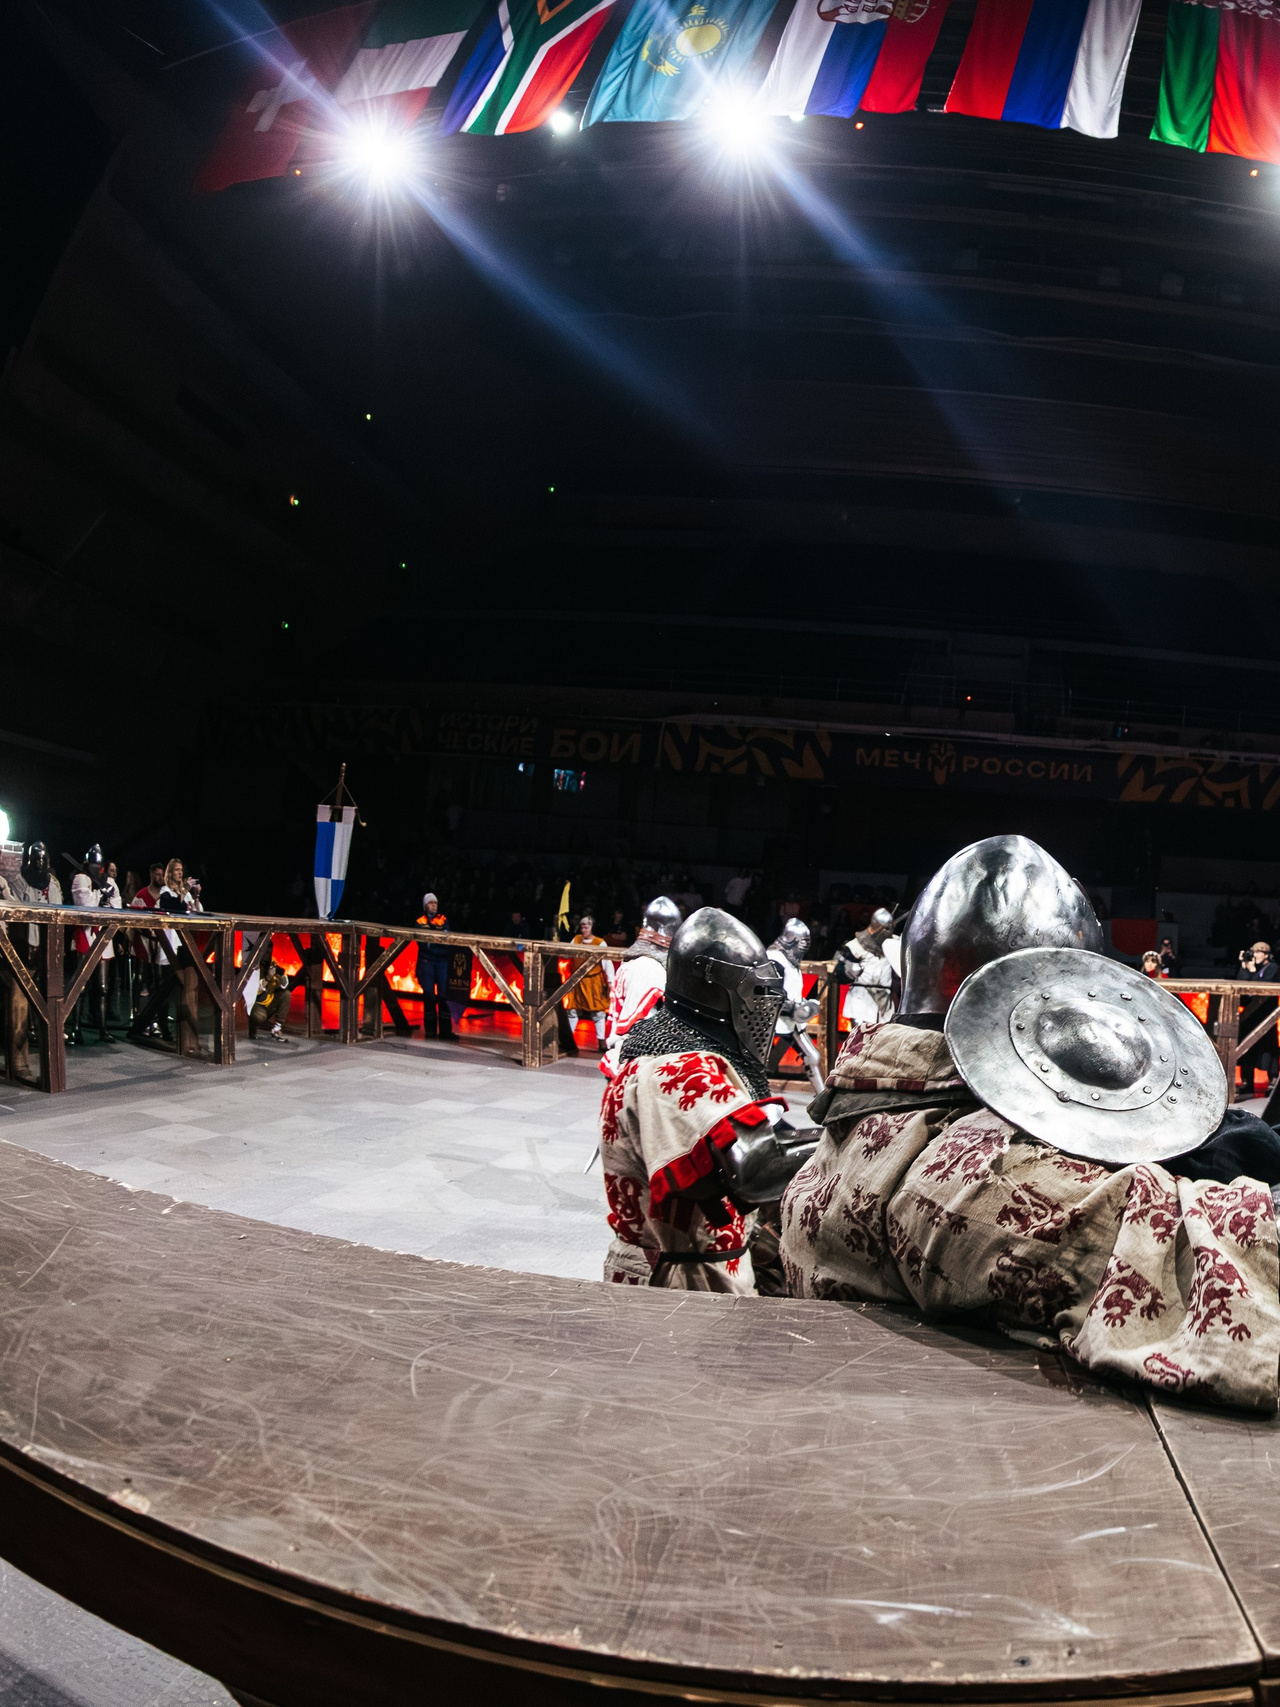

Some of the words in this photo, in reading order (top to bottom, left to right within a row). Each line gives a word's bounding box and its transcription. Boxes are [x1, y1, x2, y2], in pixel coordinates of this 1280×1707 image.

[550, 728, 642, 764] БОИ
[855, 747, 921, 770] МЕЧ
[962, 755, 1093, 782] РОССИИ
